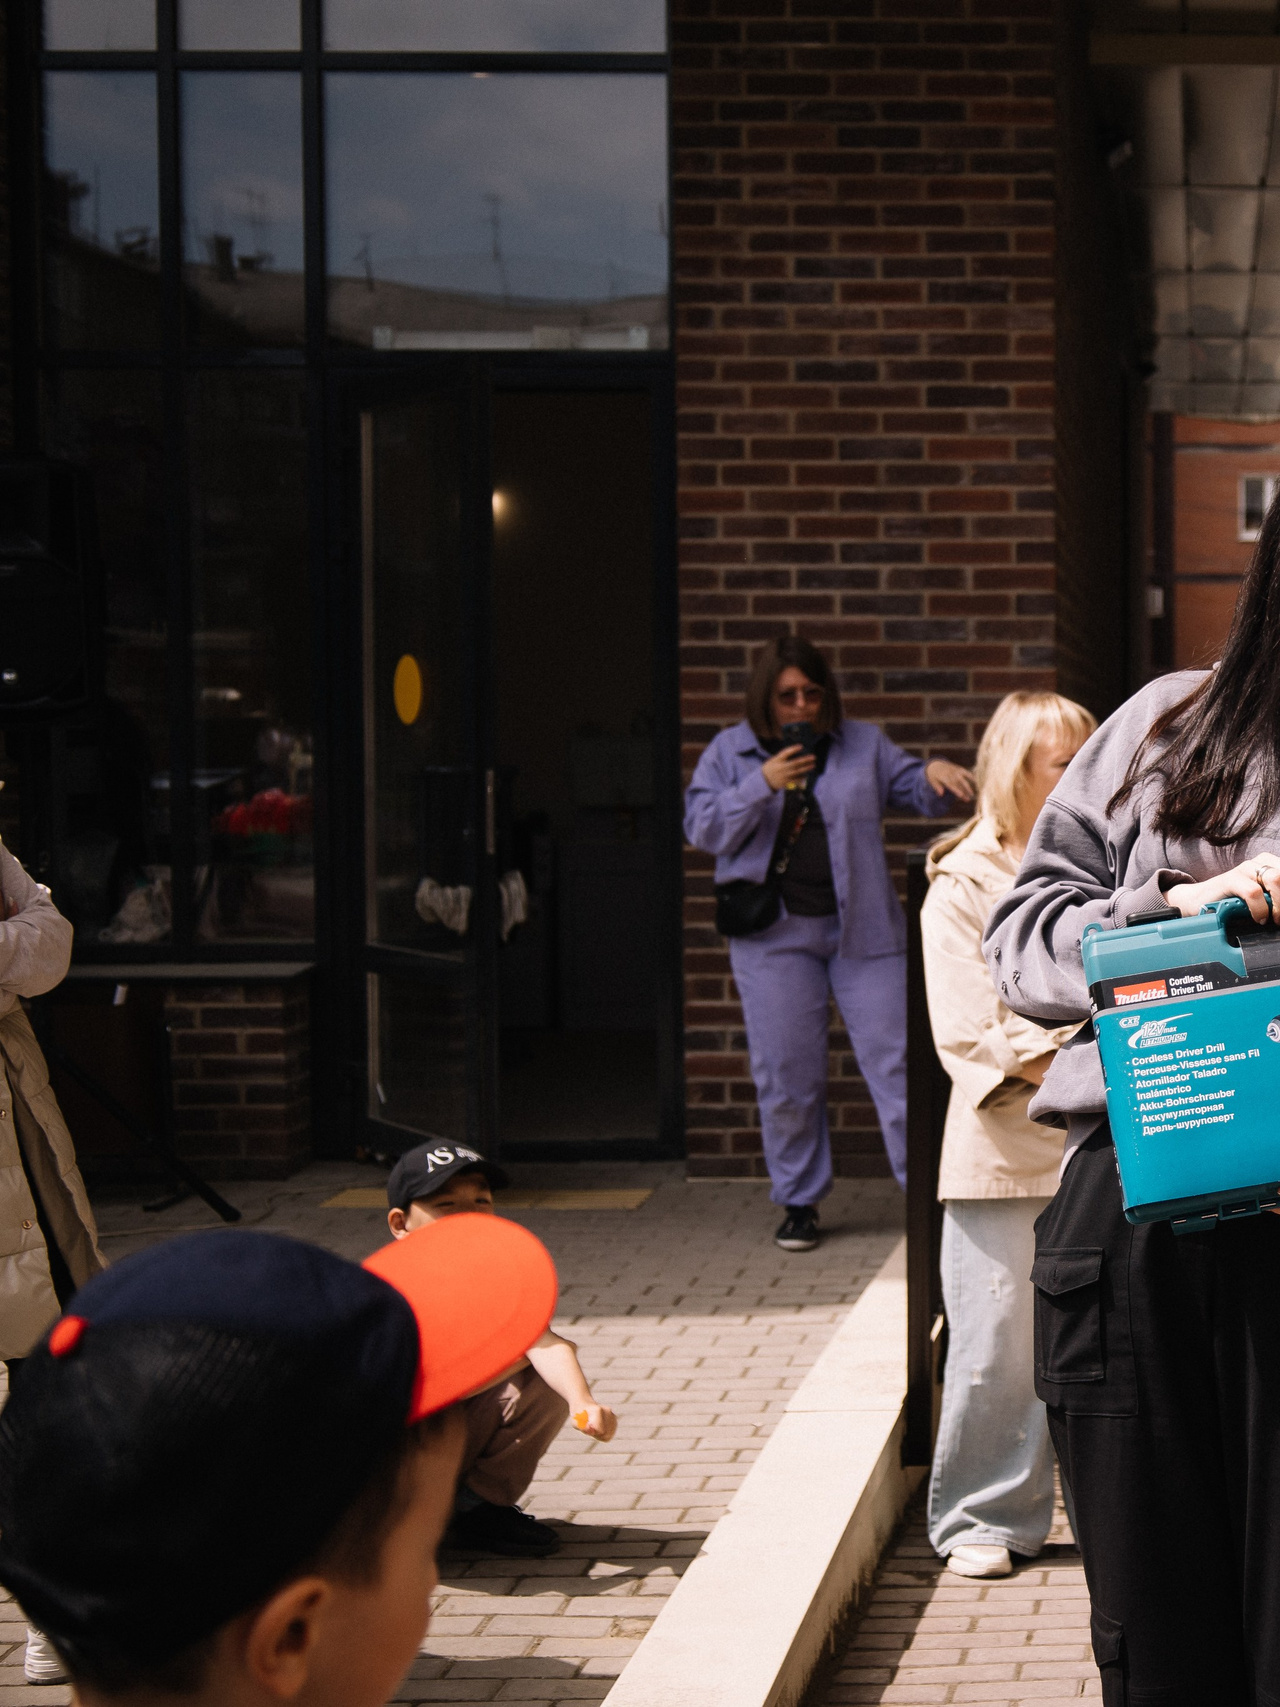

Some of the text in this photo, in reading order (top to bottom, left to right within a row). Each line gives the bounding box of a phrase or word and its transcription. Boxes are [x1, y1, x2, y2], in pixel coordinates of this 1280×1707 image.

[1169, 975, 1204, 987] Cordless
[1171, 982, 1214, 997] Driver Drill
[1132, 1043, 1225, 1066] Cordless Driver Drill
[1133, 1048, 1260, 1077] Perceuse-Visseuse sans Fil
[1135, 1066, 1227, 1089] Atornillador Taladro
[1136, 1084, 1192, 1100] Inalámbrico
[1139, 1088, 1236, 1112] Akku-Bohrschrauber
[1141, 1103, 1225, 1124] Аккумуляторная
[1142, 1113, 1235, 1136] Дрель-шуруповерт
